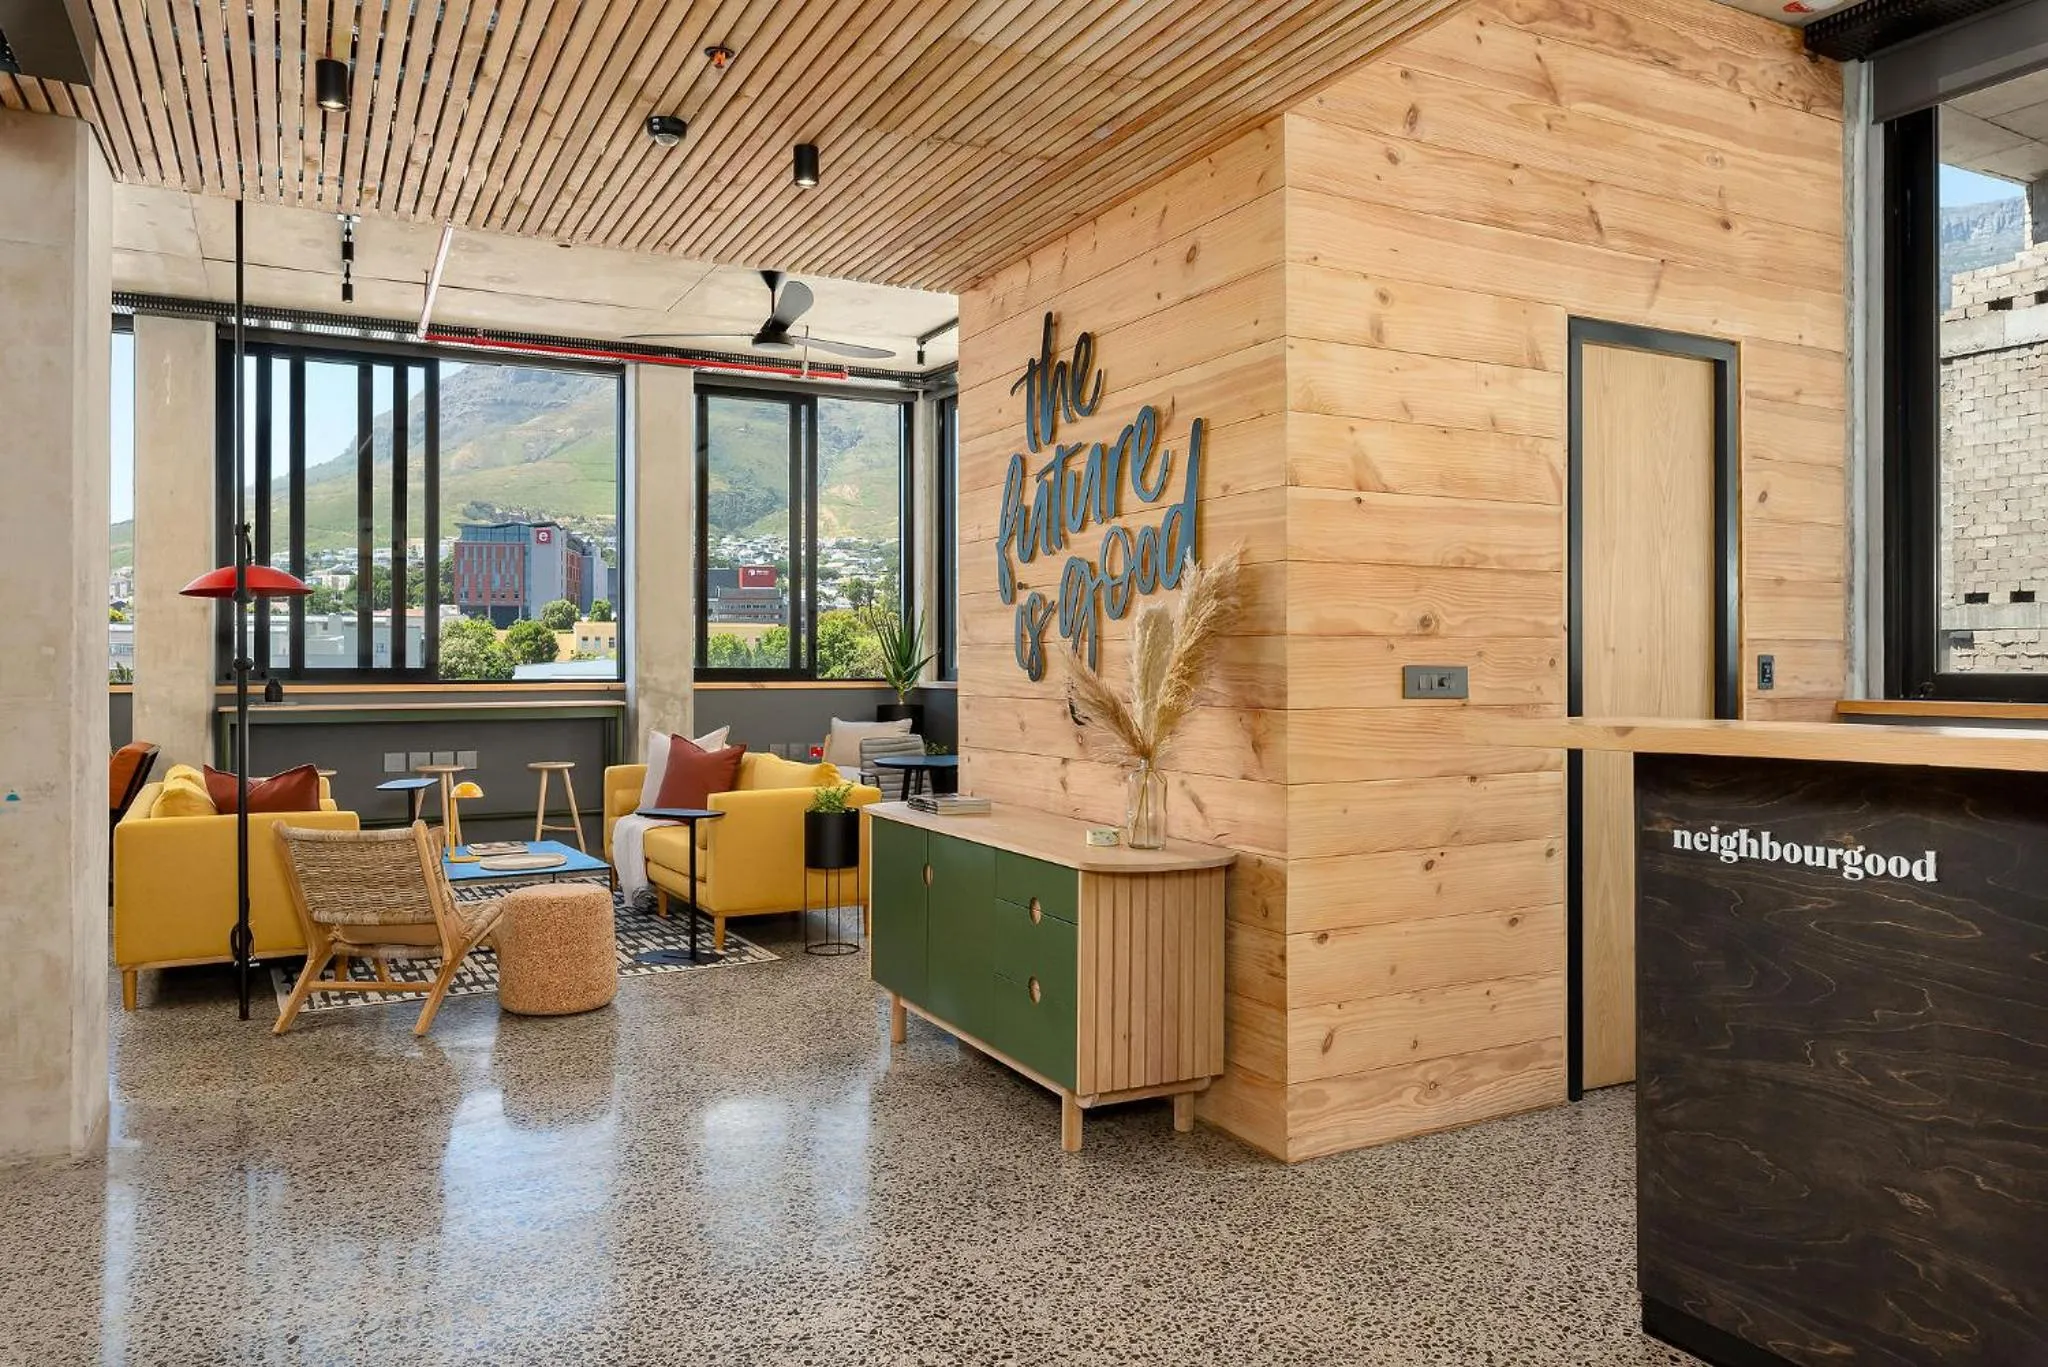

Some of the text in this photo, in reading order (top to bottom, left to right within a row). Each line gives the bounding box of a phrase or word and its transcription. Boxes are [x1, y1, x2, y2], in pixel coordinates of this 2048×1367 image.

[1011, 311, 1103, 454] the
[996, 405, 1170, 605] future
[1014, 417, 1204, 682] is good
[1672, 825, 1938, 883] neighbourgood
